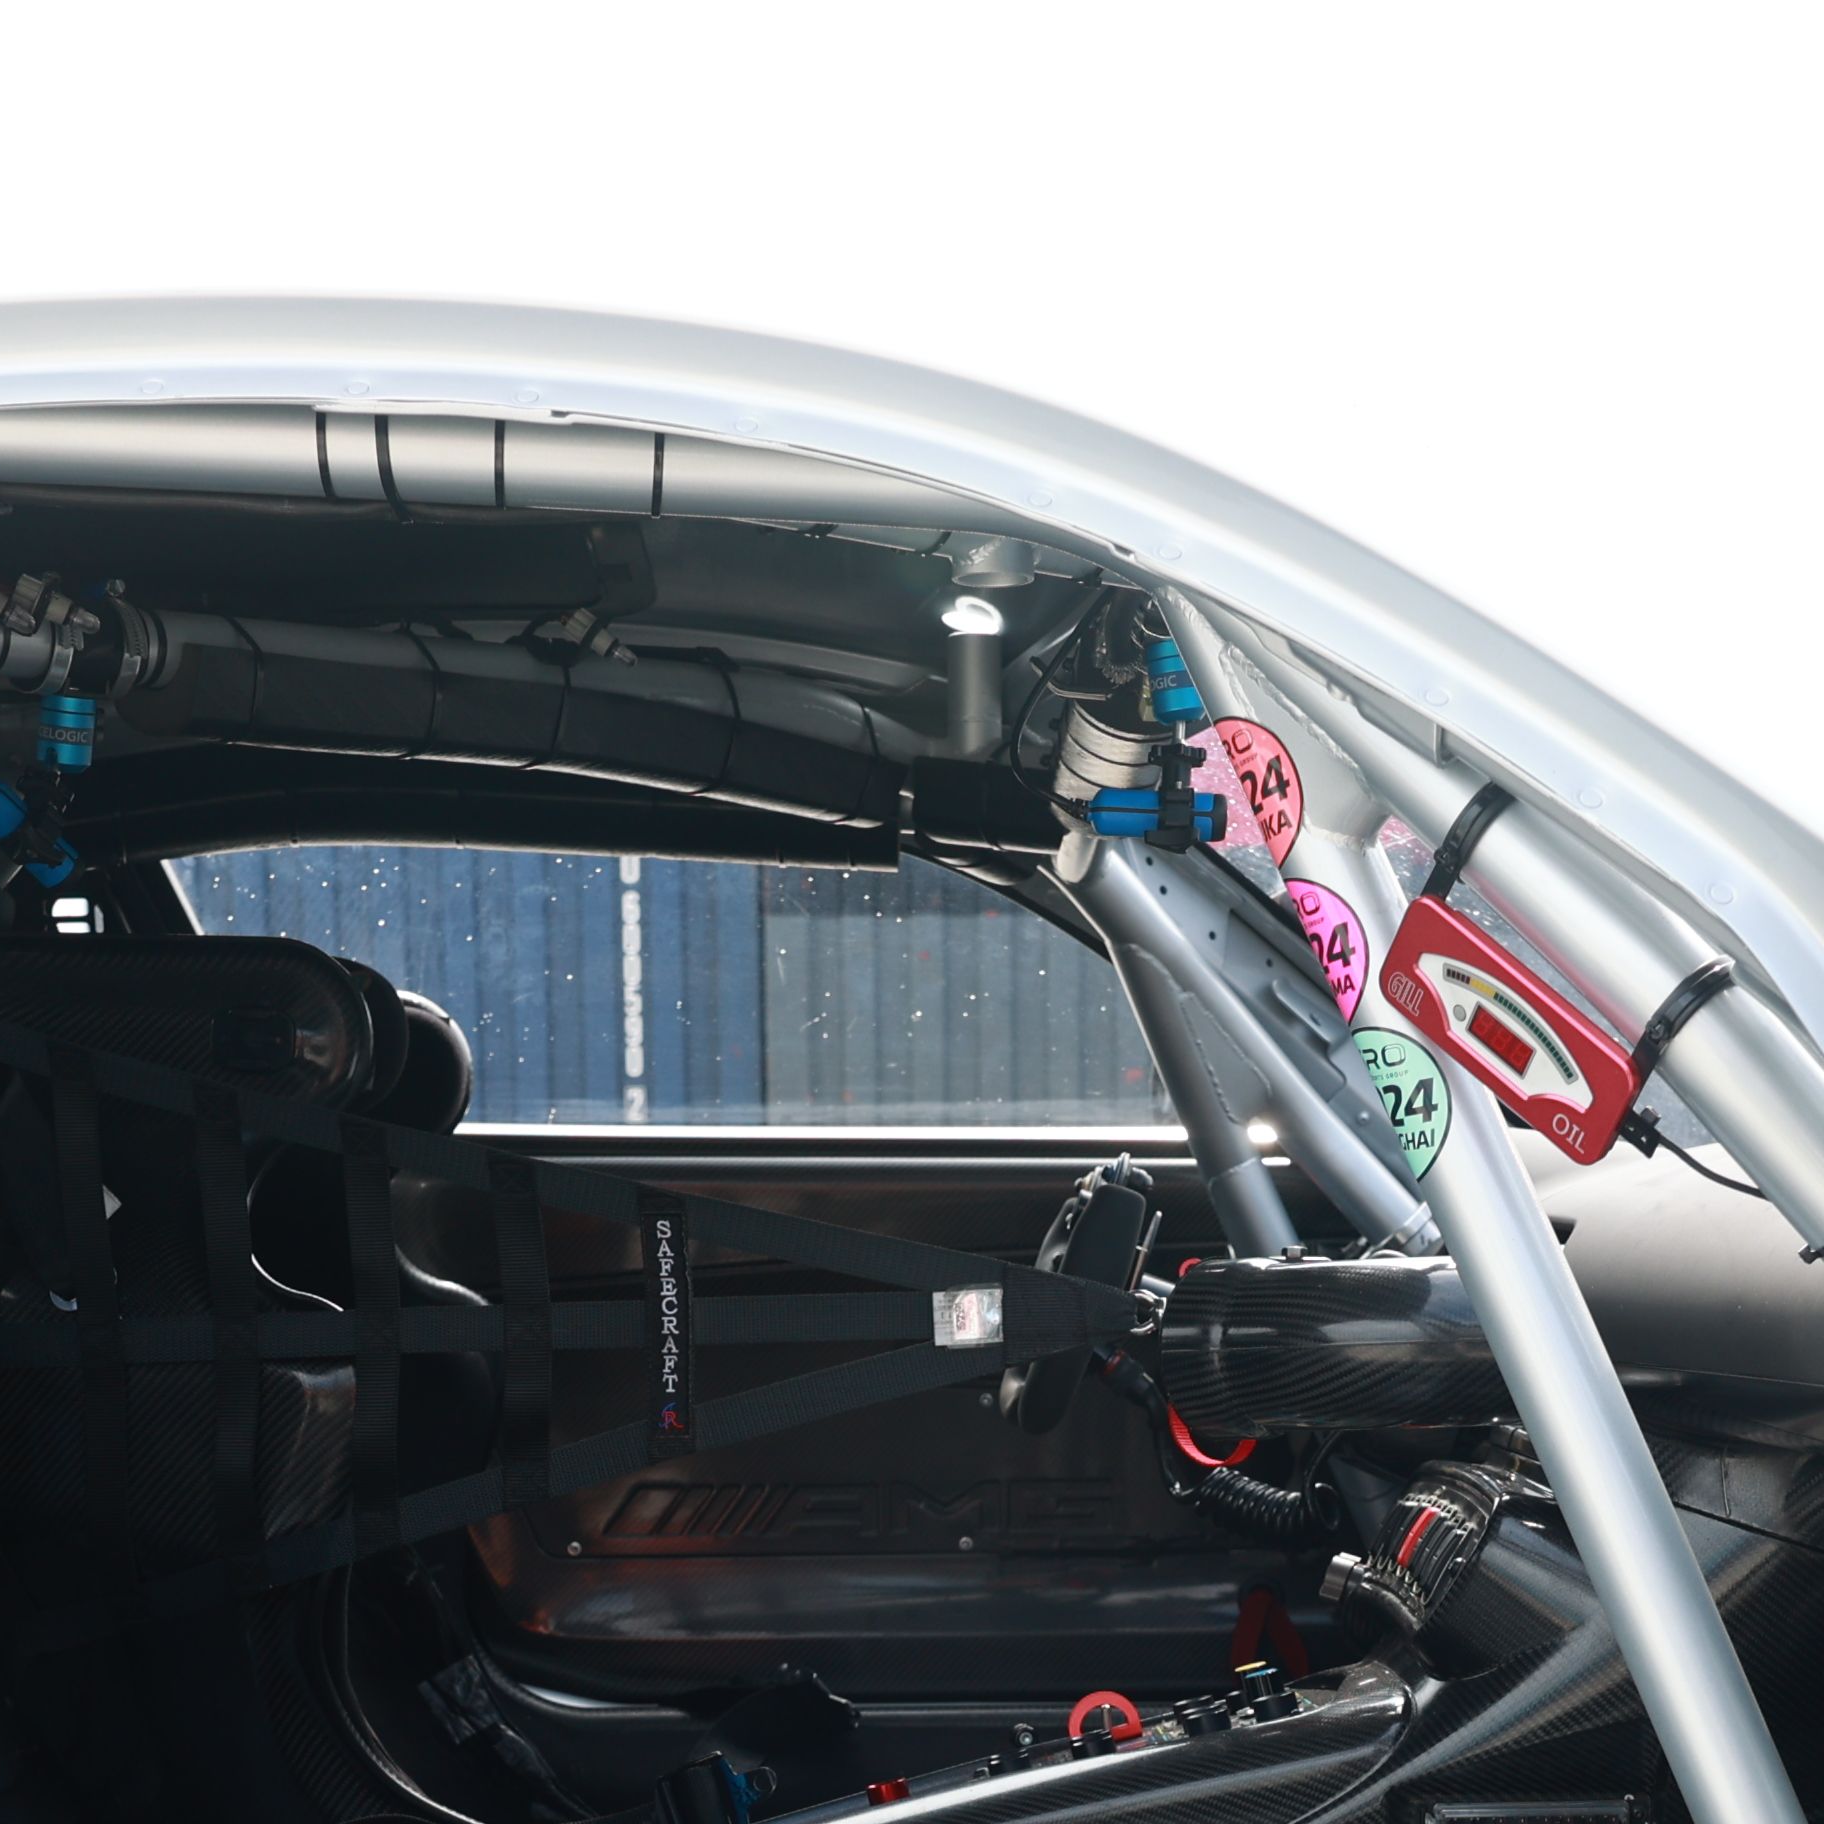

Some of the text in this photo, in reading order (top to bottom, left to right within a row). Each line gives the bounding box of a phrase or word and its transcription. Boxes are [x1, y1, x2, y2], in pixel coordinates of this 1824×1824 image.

[1239, 754, 1291, 816] 24
[1387, 970, 1425, 1017] GILL
[1551, 1112, 1586, 1155] OIL
[656, 1220, 680, 1393] SAFECRAFT
